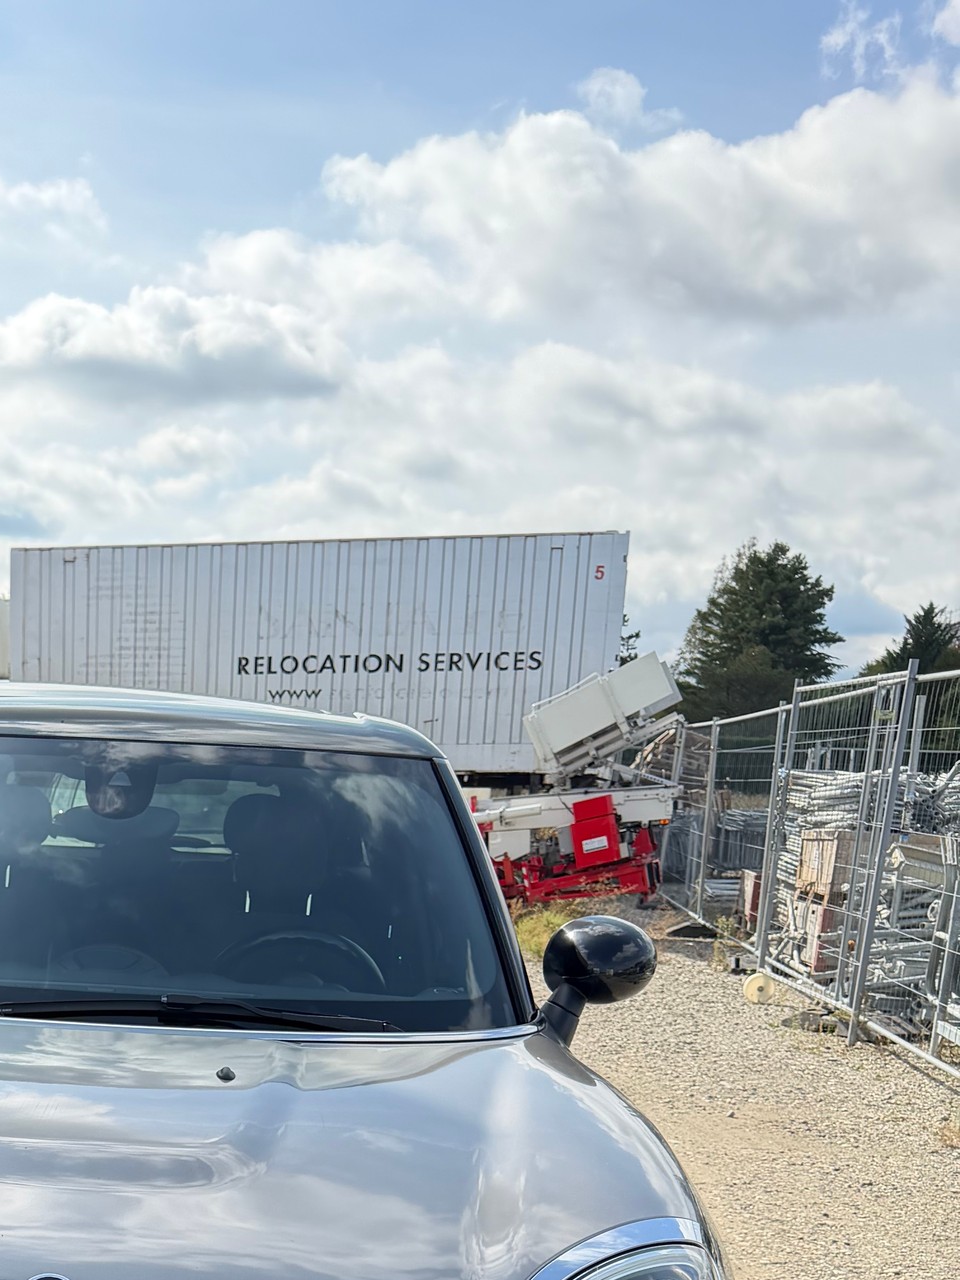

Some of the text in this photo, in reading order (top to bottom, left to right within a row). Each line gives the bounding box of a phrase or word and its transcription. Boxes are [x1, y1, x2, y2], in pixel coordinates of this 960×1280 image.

[594, 565, 605, 580] 5
[237, 651, 543, 675] RELOCATION SERVICES
